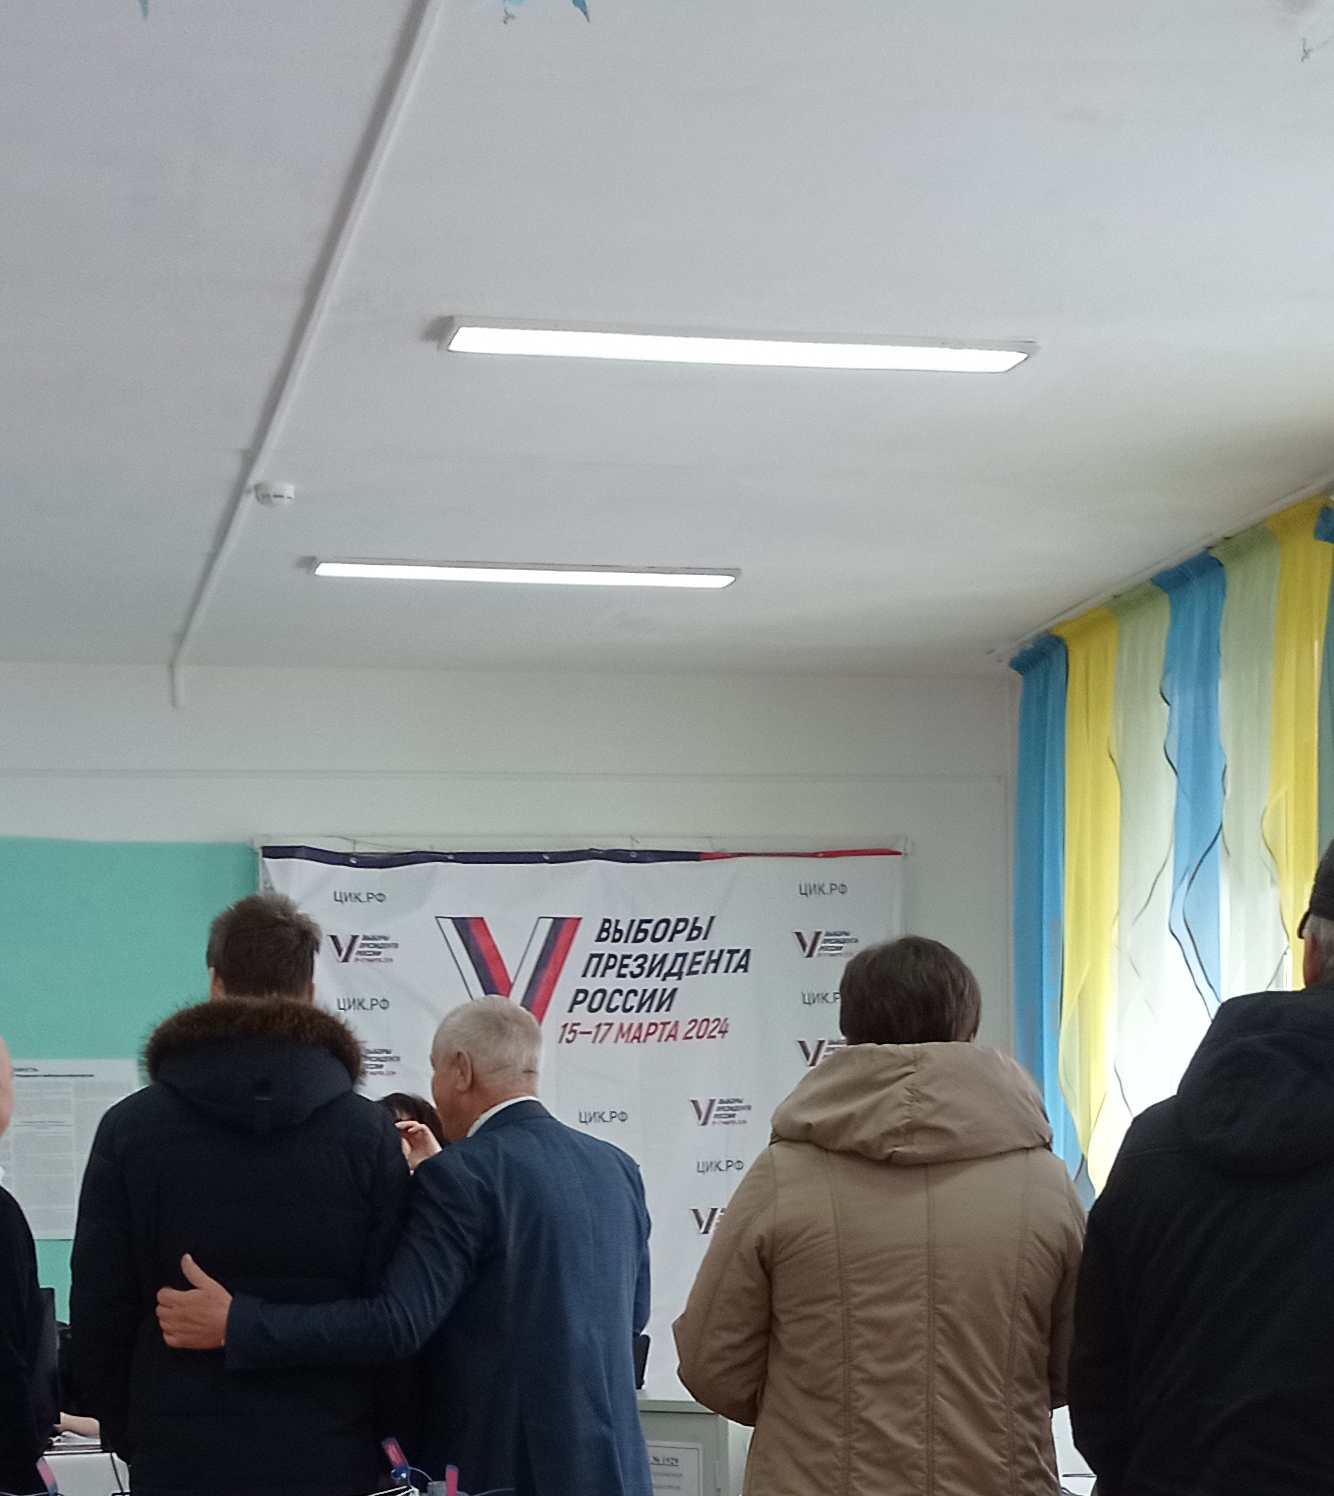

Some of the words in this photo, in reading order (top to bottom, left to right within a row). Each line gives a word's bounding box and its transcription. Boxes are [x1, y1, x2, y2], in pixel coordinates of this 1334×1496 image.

[333, 890, 387, 904] ЦИК.РФ
[798, 882, 848, 897] ЦИК.РФ
[594, 915, 716, 944] ВЫБОРЫ
[581, 948, 752, 982] ПРЕЗИДЕНТА
[337, 997, 390, 1011] ЦИК.РФ
[567, 986, 679, 1014] РОССИИ
[801, 990, 840, 1006] ЦИК.Р
[614, 1019, 678, 1044] МАРТА
[682, 1017, 730, 1041] 2024
[578, 1110, 628, 1125] ЦИК.РФ
[696, 1159, 744, 1174] ЦИК.РФ
